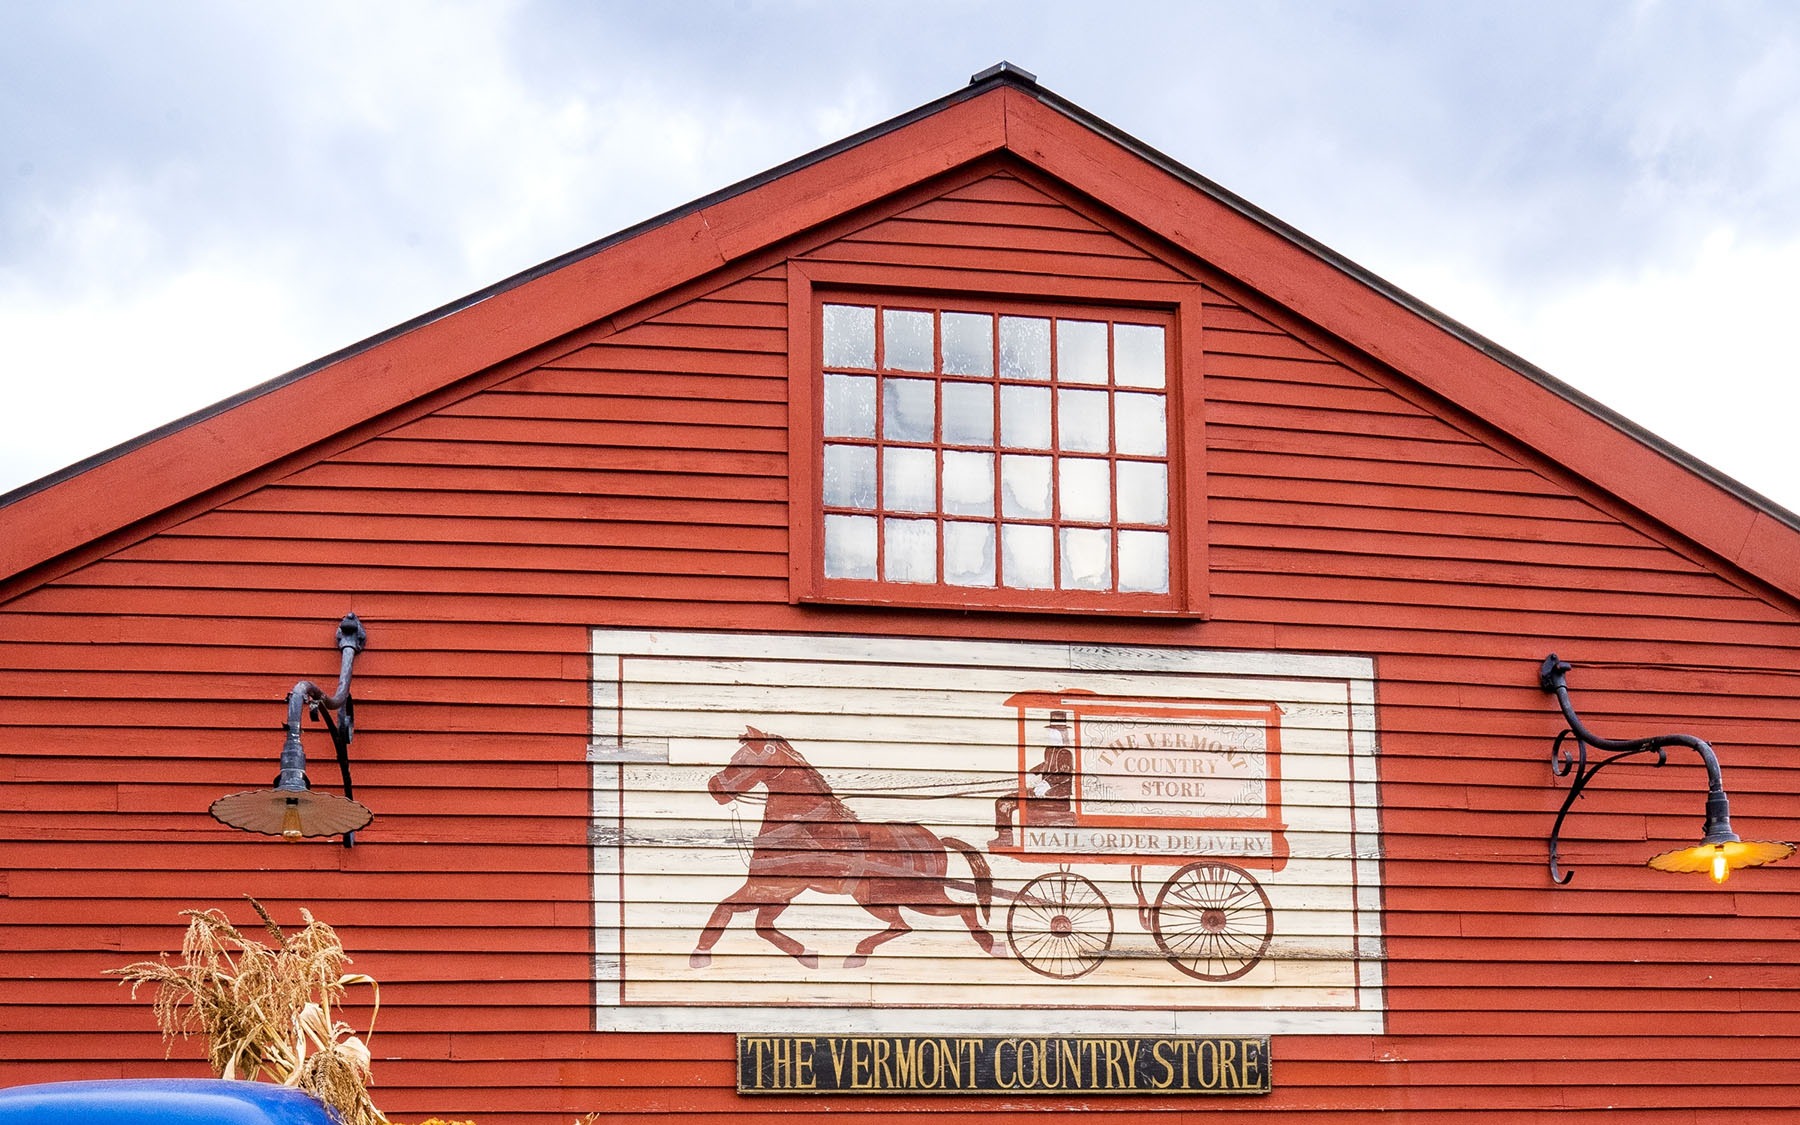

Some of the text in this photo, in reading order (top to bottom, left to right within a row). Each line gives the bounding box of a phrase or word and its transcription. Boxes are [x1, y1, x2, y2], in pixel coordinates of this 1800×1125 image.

[1098, 733, 1249, 770] THE VERMONT
[1124, 757, 1218, 775] COUNTRY
[1141, 780, 1206, 799] STORE
[1028, 830, 1269, 852] MAIL ORDER DELIVERY
[748, 1038, 1262, 1090] THE VERMONT COUNTRY STORE
